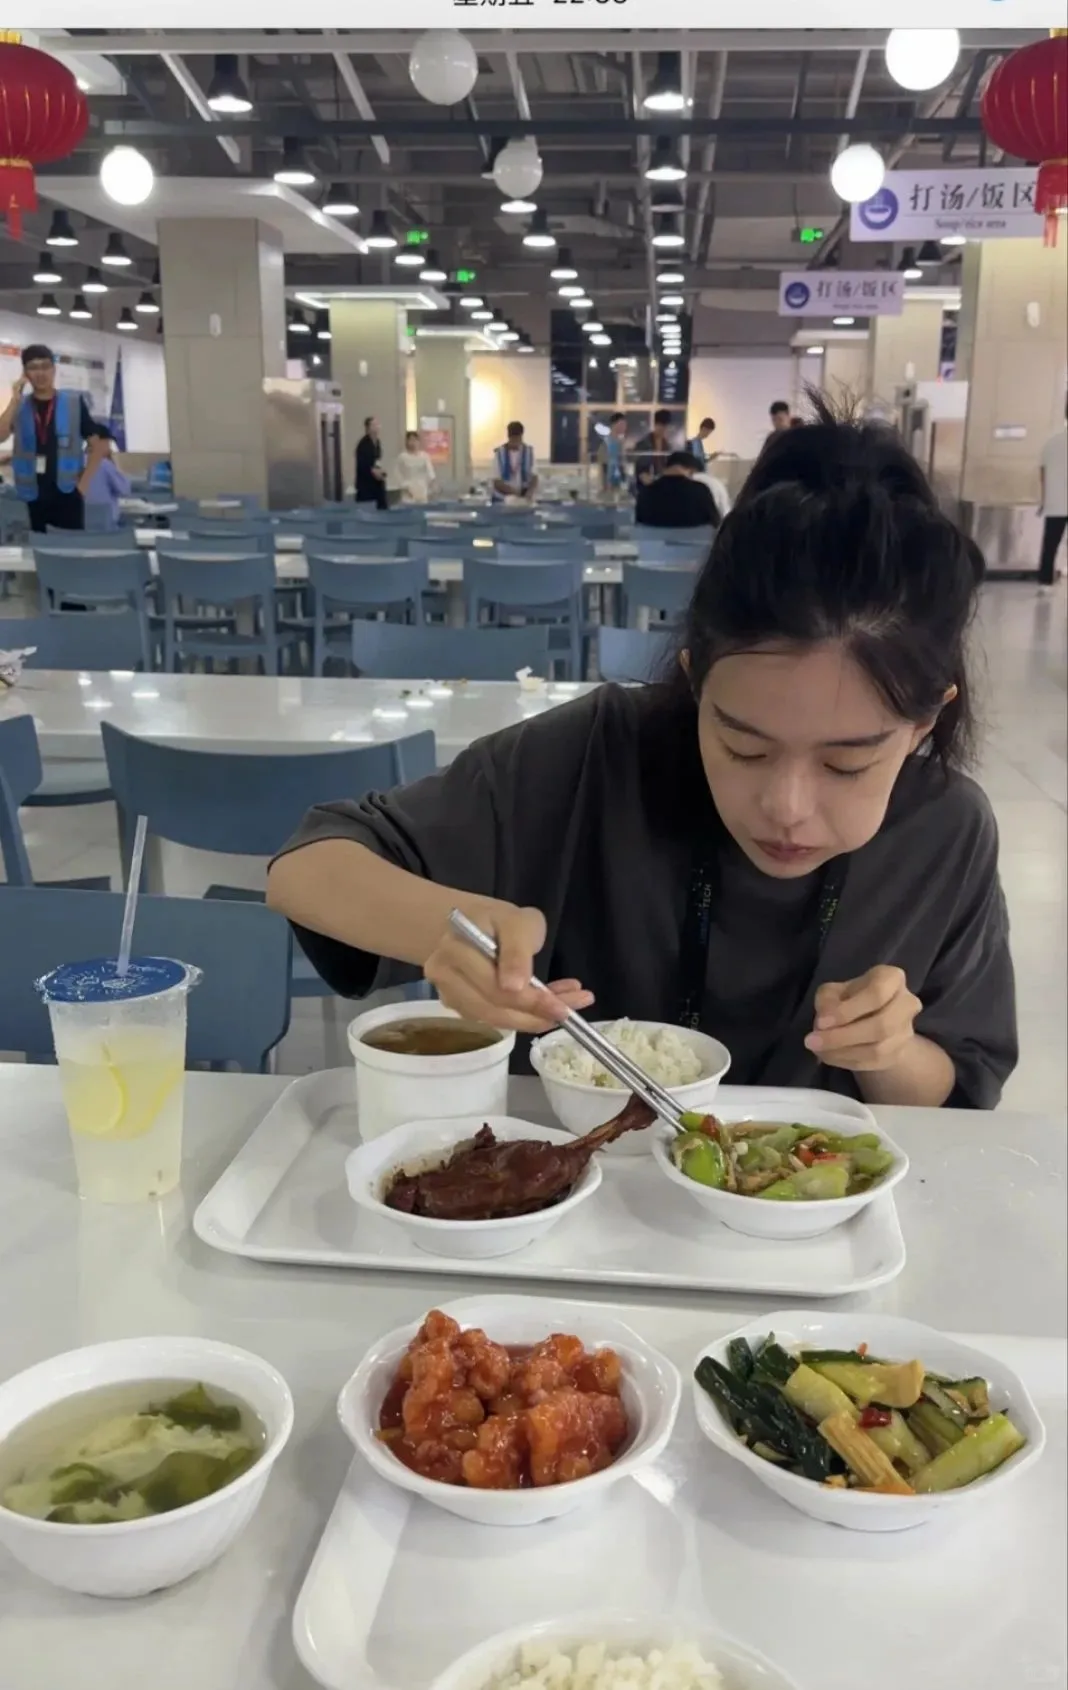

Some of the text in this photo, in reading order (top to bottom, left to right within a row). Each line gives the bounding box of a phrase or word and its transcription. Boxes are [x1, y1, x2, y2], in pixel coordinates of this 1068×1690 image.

[909, 181, 1036, 212] 打汤/饭区
[816, 280, 898, 298] 打汤/饭区
